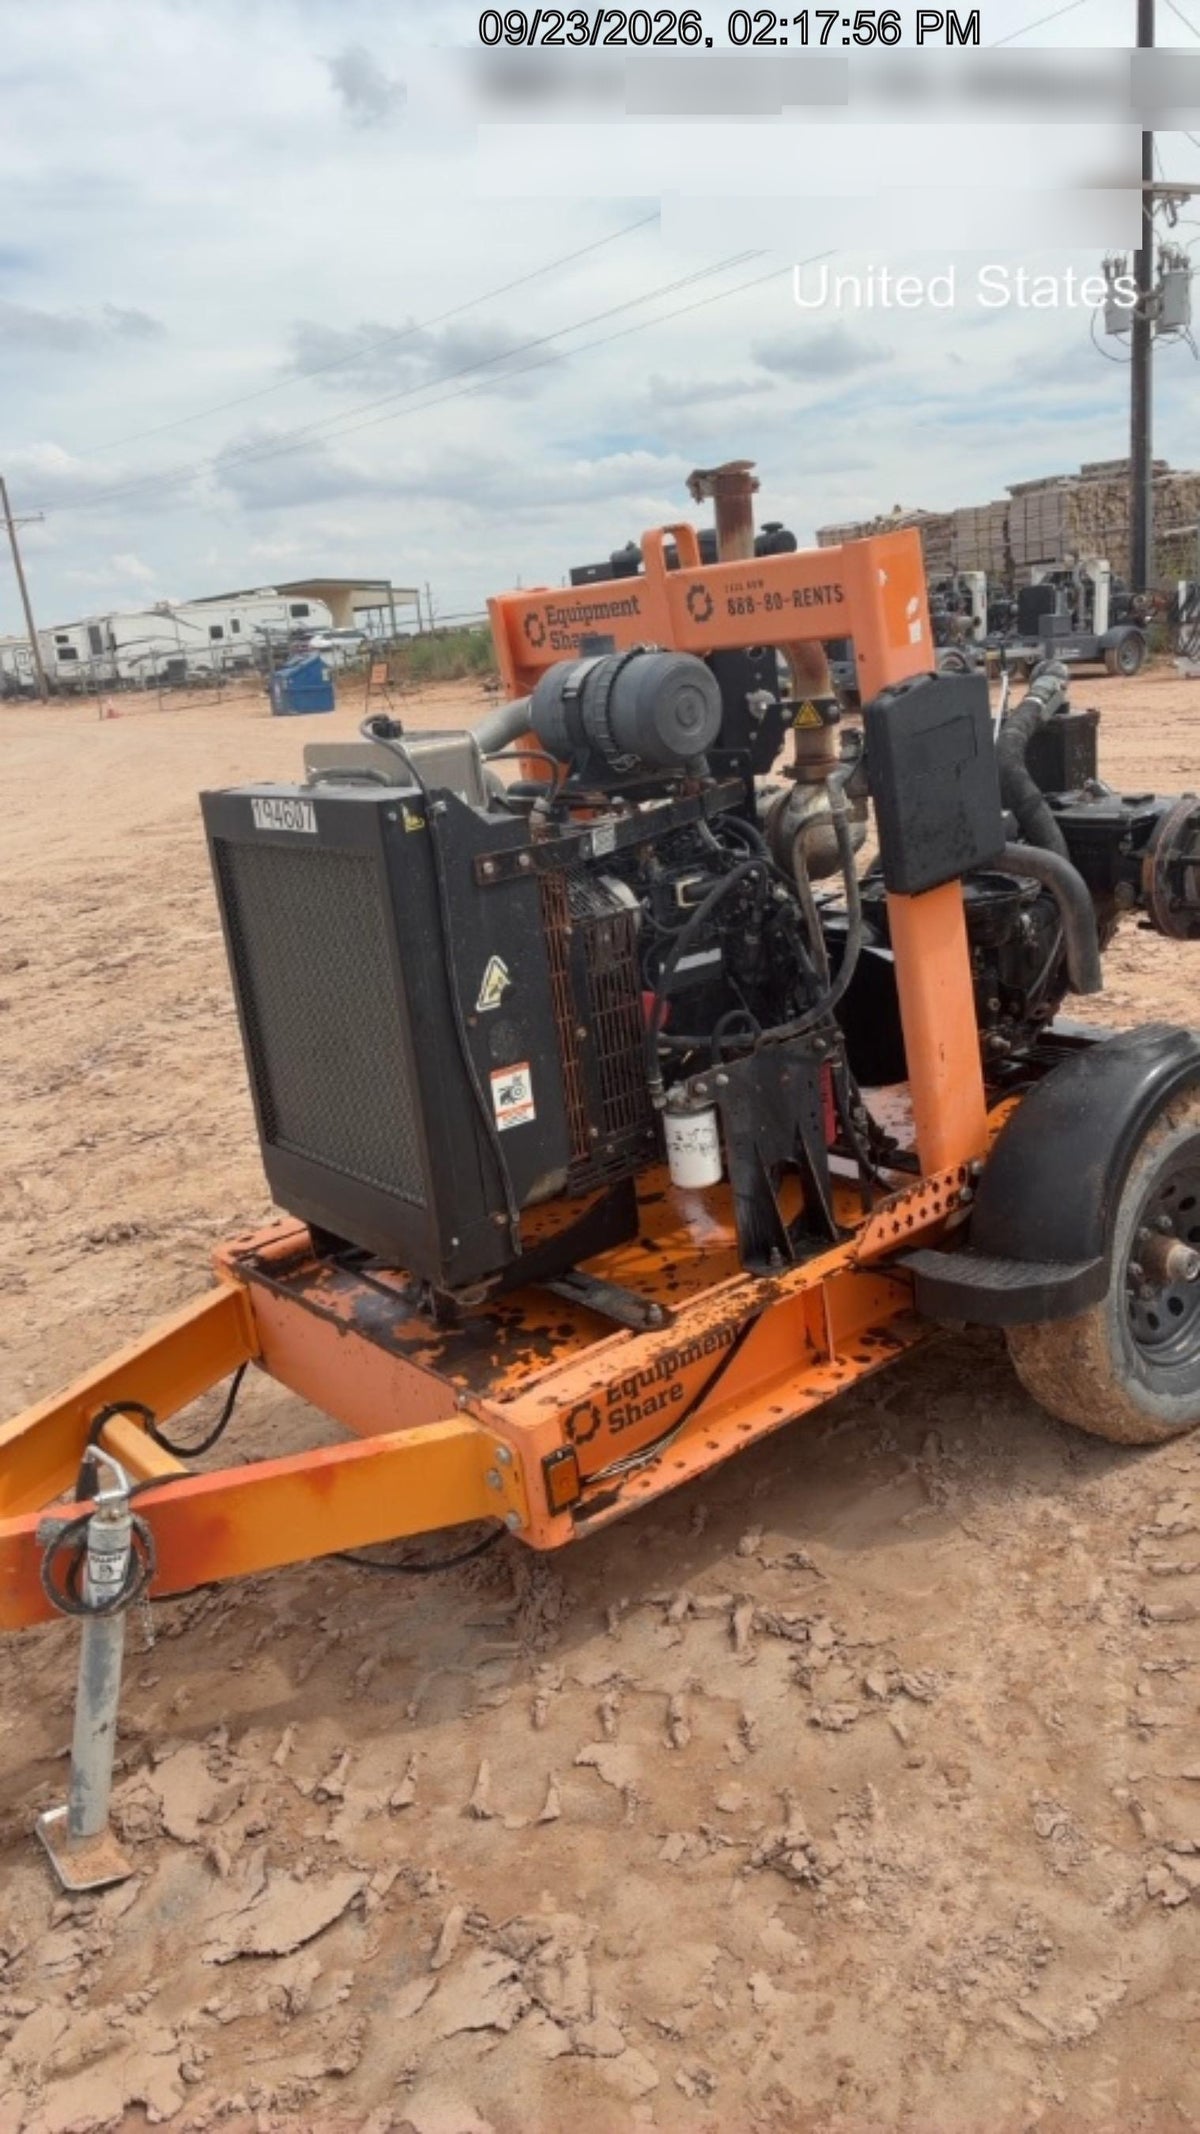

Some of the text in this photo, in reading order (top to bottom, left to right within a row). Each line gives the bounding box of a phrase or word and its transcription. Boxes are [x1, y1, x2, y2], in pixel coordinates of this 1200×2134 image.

[545, 595, 641, 628] Equipment
[727, 583, 844, 616] 888-80-RENTS
[254, 800, 313, 830] 194607
[608, 1382, 684, 1434] Share
